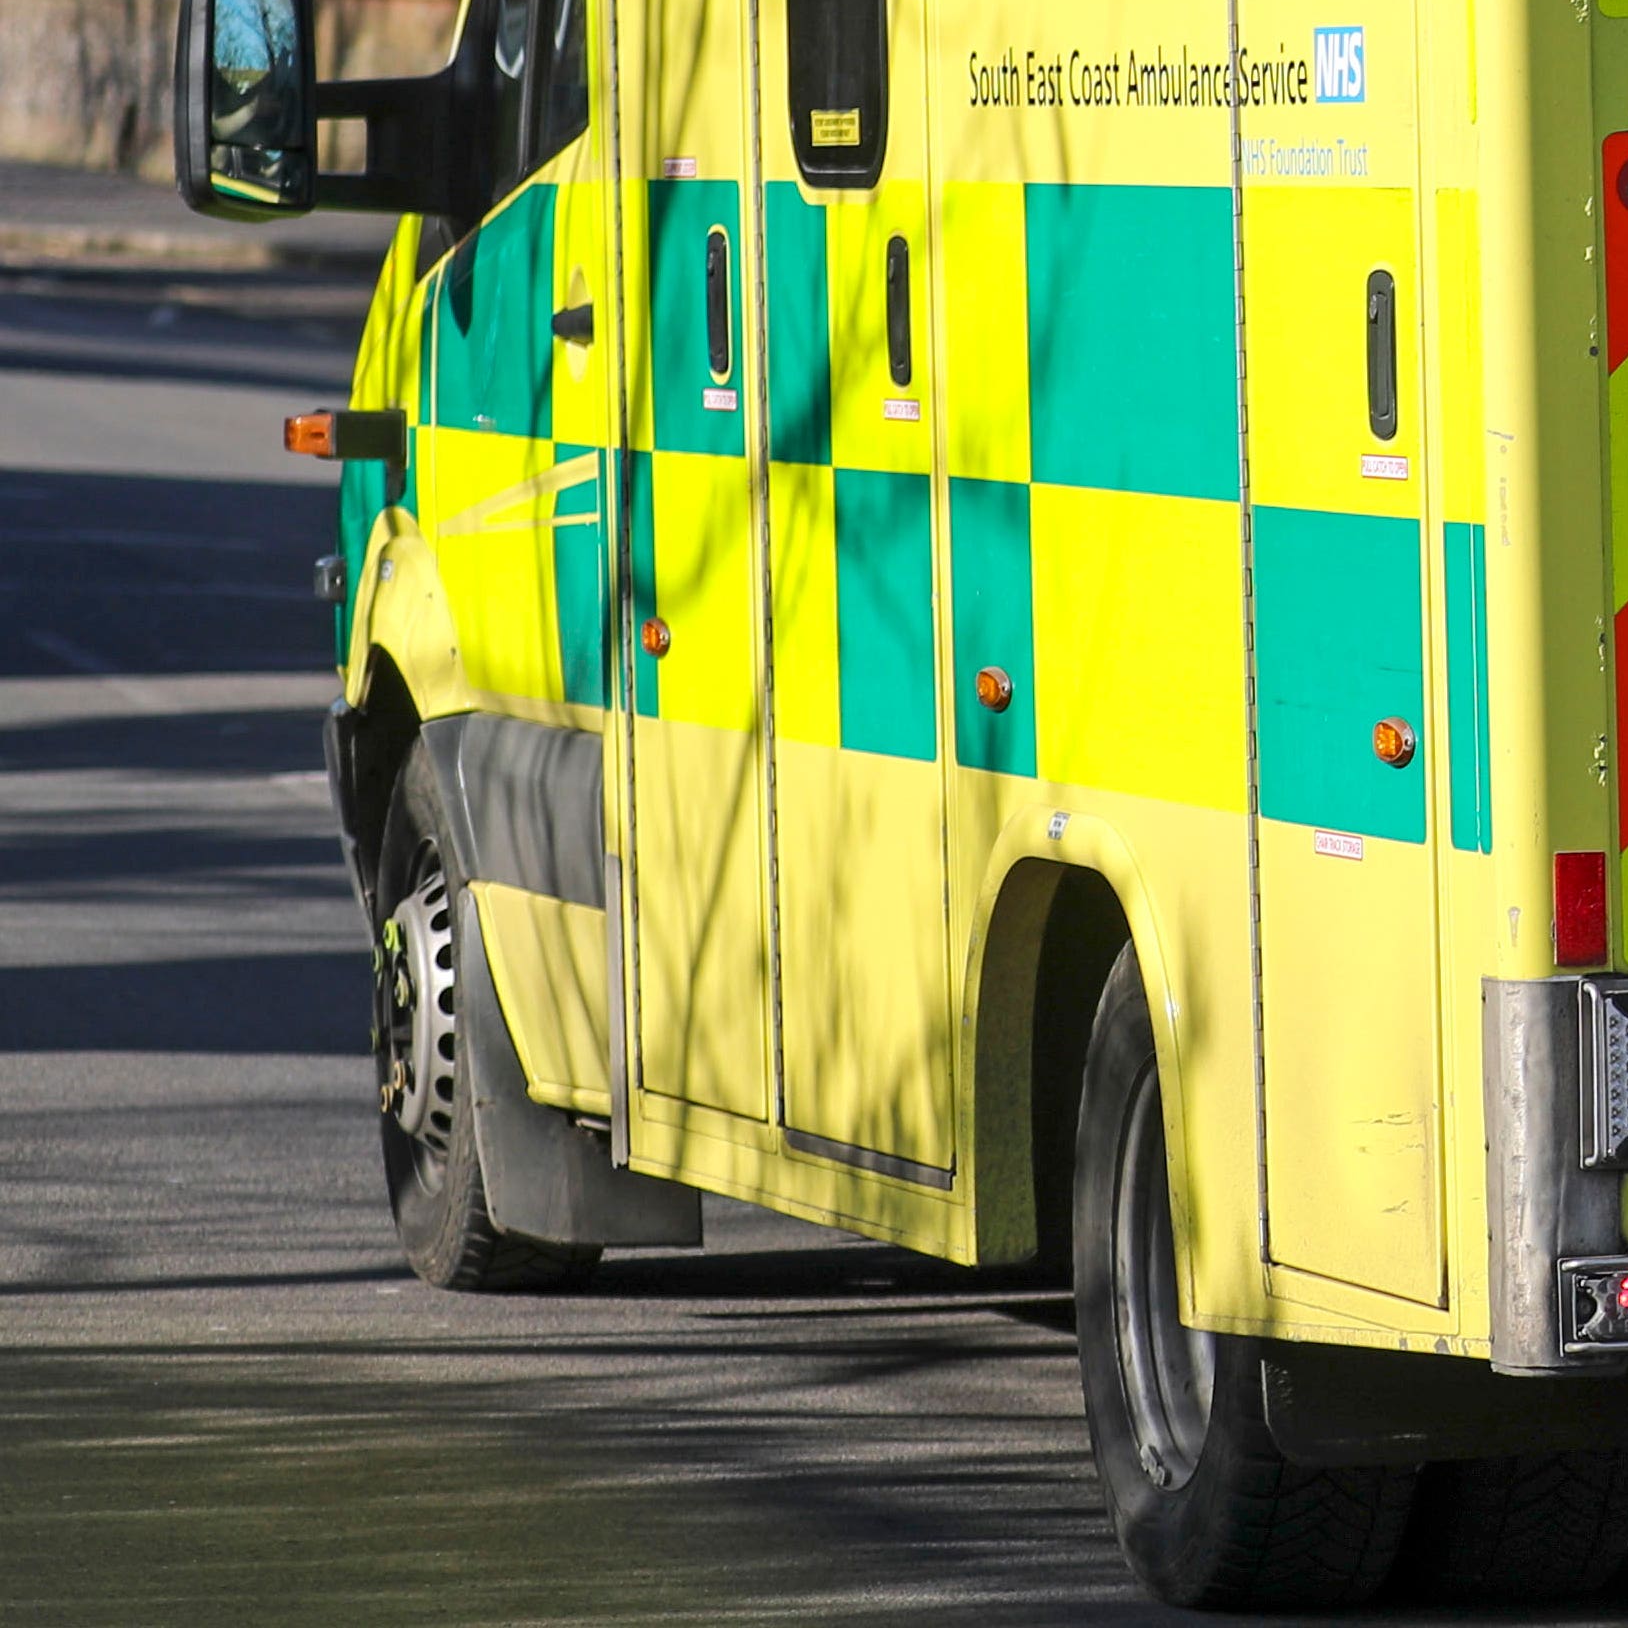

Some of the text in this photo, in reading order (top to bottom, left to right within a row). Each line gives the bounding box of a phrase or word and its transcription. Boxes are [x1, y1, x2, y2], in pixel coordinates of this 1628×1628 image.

[969, 31, 1363, 108] South East Coast Ambulance Service NHS
[1242, 136, 1369, 176] NHS Foundation Trust
